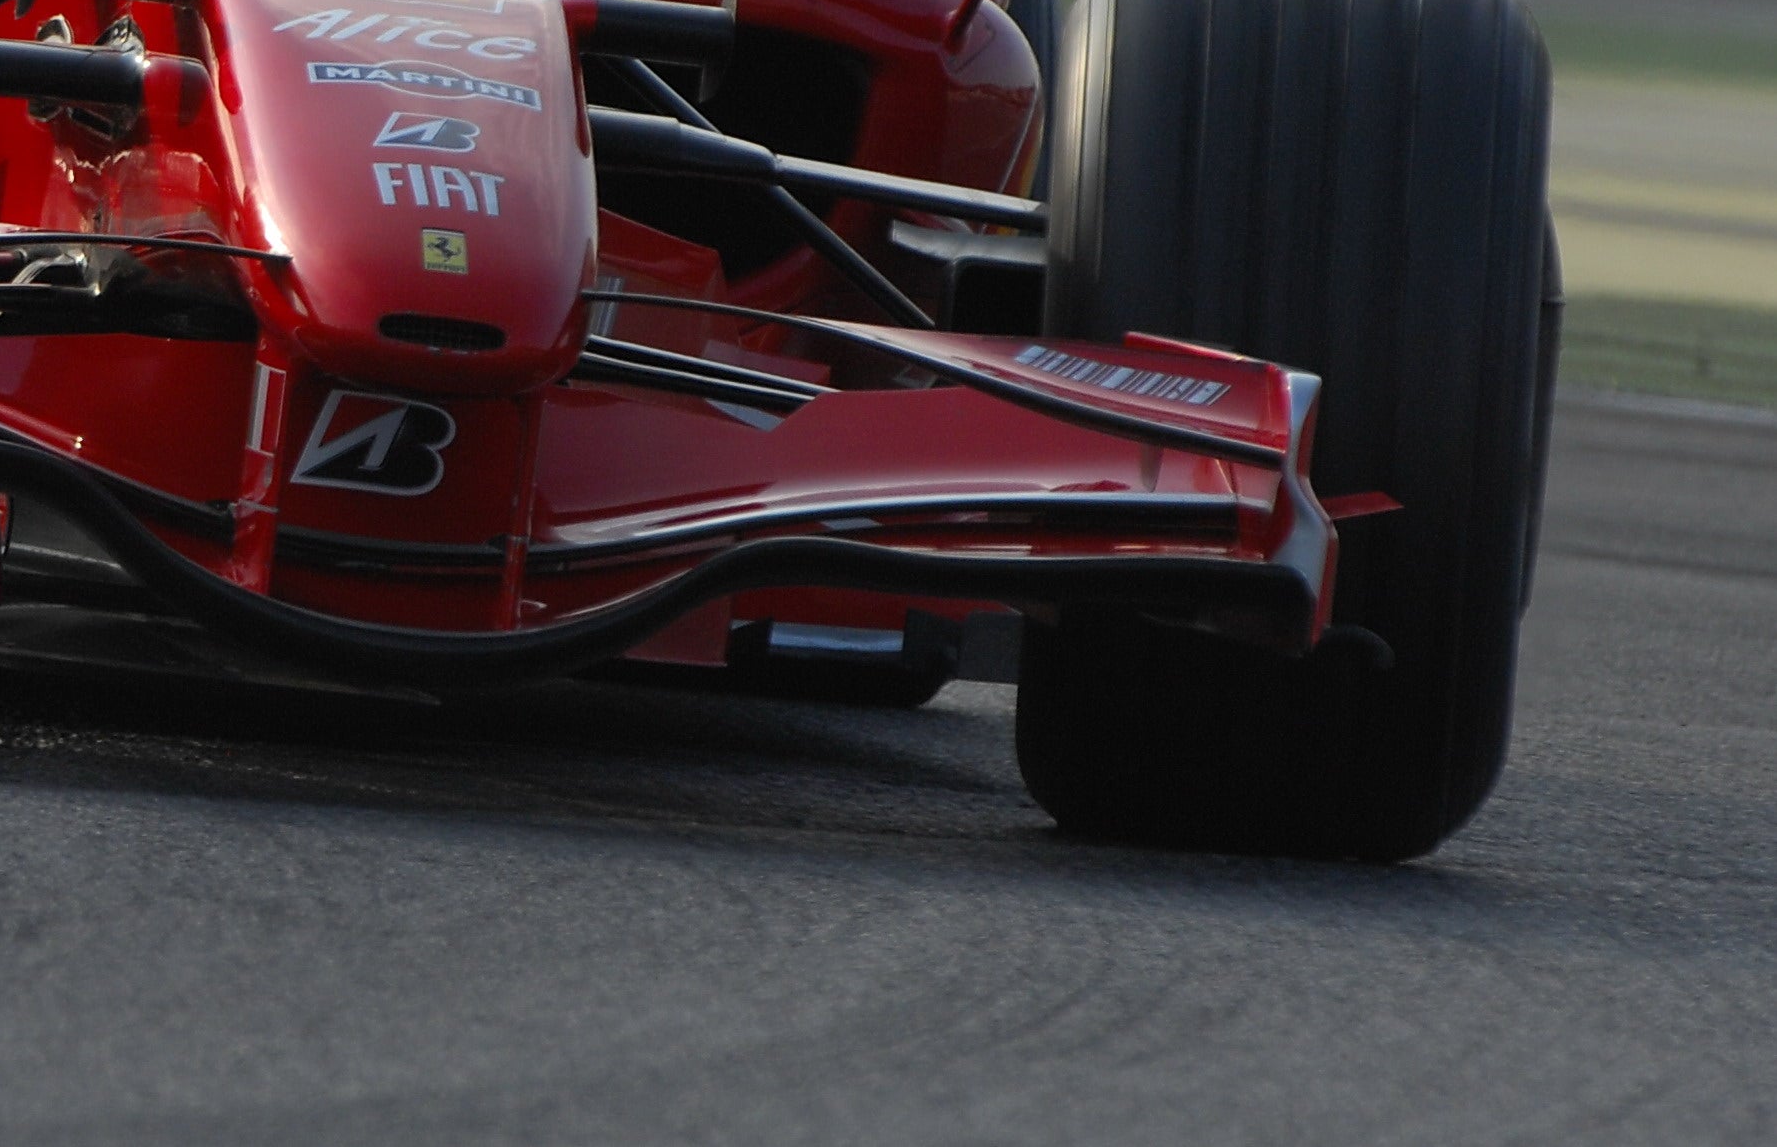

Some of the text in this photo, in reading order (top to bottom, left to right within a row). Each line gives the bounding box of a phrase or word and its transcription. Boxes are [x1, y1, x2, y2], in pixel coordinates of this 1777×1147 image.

[273, 8, 537, 59] Alice
[326, 67, 524, 101] MARTINI
[373, 162, 505, 216] FIAT
